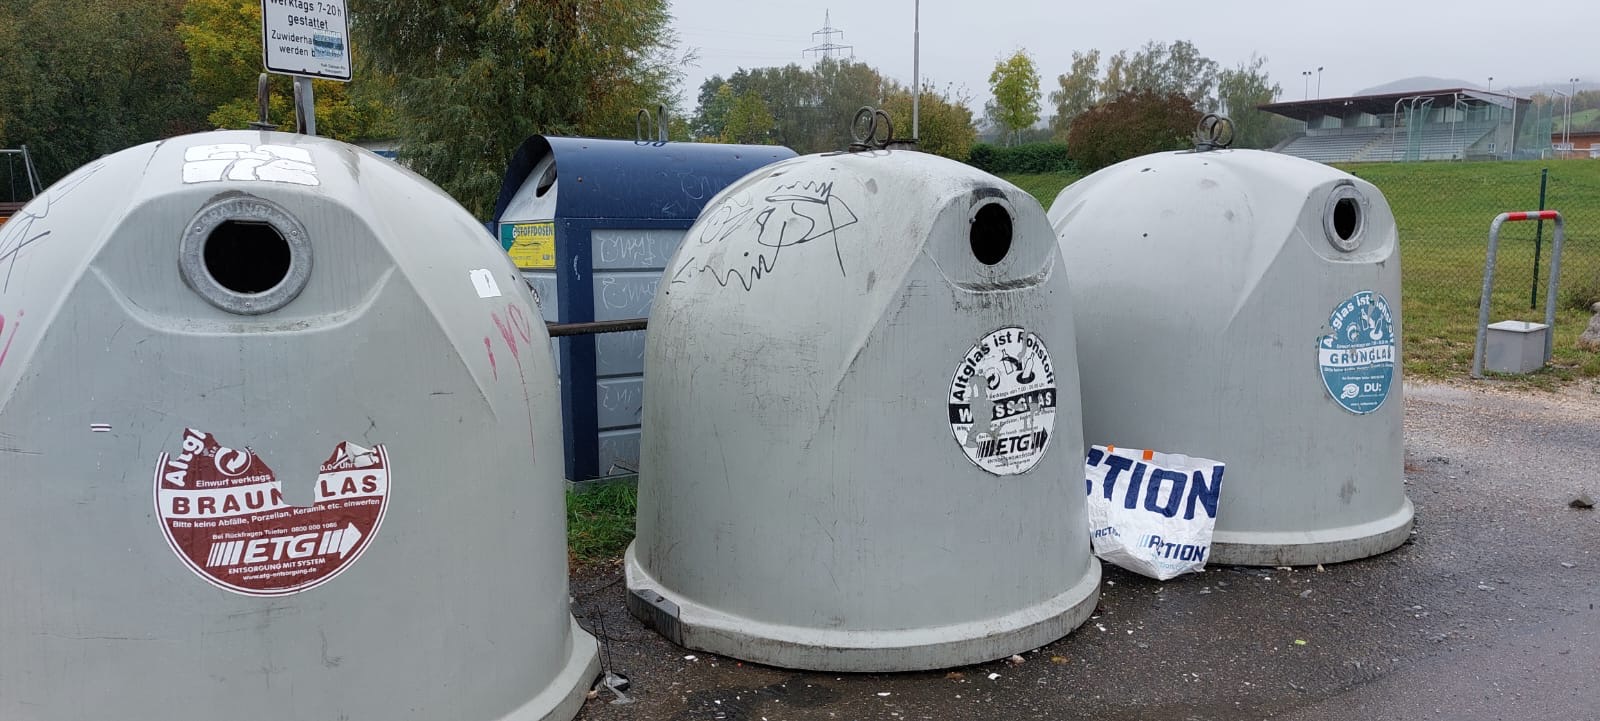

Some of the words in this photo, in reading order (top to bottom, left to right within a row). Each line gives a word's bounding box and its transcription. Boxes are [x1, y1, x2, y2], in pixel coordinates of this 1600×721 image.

[288, 14, 329, 29] gestattet
[280, 46, 309, 57] werden
[952, 343, 991, 402] Altglas
[993, 331, 1012, 347] ist
[1363, 382, 1382, 393] DU:
[195, 478, 230, 488] Einwurf
[231, 473, 271, 485] werktags
[172, 520, 193, 529] Bitte
[194, 520, 217, 529] keine
[293, 503, 326, 516] Keramik
[344, 498, 381, 508] einwerfen
[243, 532, 319, 564] ETG
[228, 562, 282, 575] ENTSORGUNG
[282, 560, 297, 569] MIT
[297, 557, 326, 568] SYSTEM
